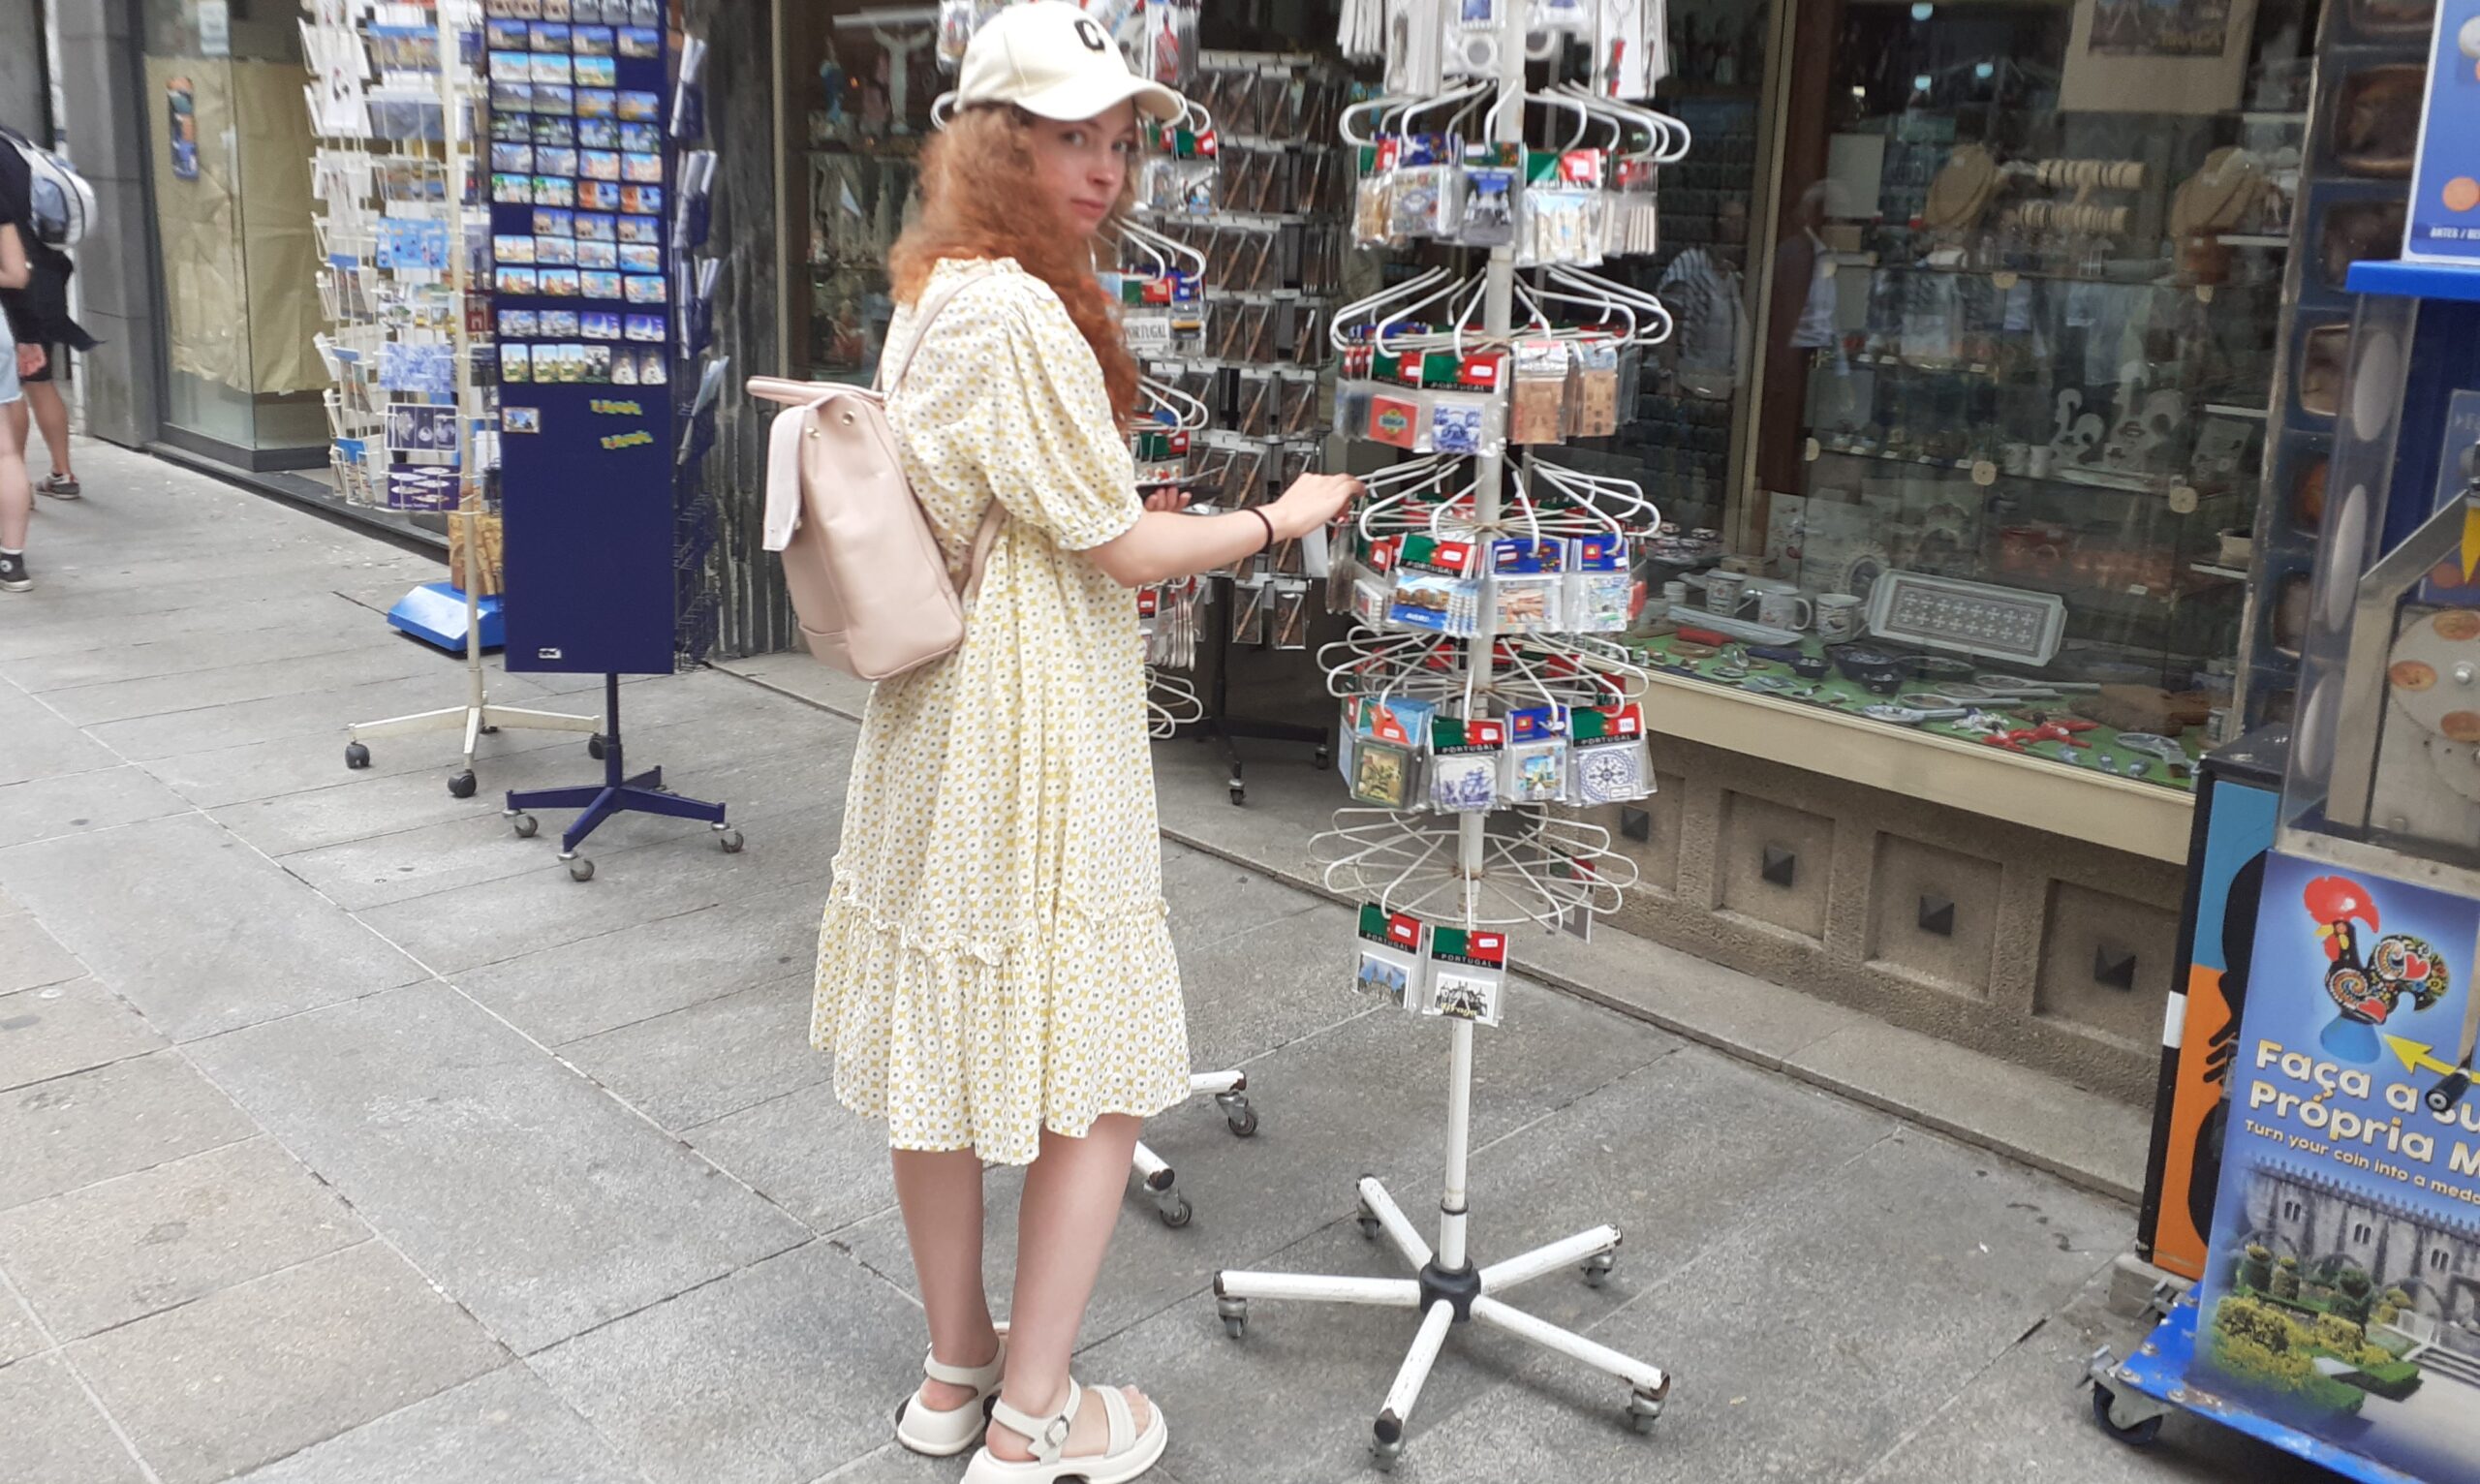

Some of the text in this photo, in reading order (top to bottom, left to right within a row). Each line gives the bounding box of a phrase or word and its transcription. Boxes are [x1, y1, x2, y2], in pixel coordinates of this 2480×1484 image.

[1442, 744, 1495, 754] PORTUGAL
[1580, 734, 1632, 745] PORTUGAL
[1366, 933, 1410, 952] PORTUGAL
[1441, 953, 1493, 968] PORTUGAL
[2256, 1038, 2372, 1100] Faça
[2385, 1082, 2419, 1113] a
[2249, 1079, 2434, 1163] Própria
[2245, 1119, 2284, 1142] Turn
[2289, 1134, 2329, 1155] your
[2334, 1148, 2370, 1169] coin
[2374, 1159, 2409, 1181] into
[2413, 1174, 2426, 1187] a
